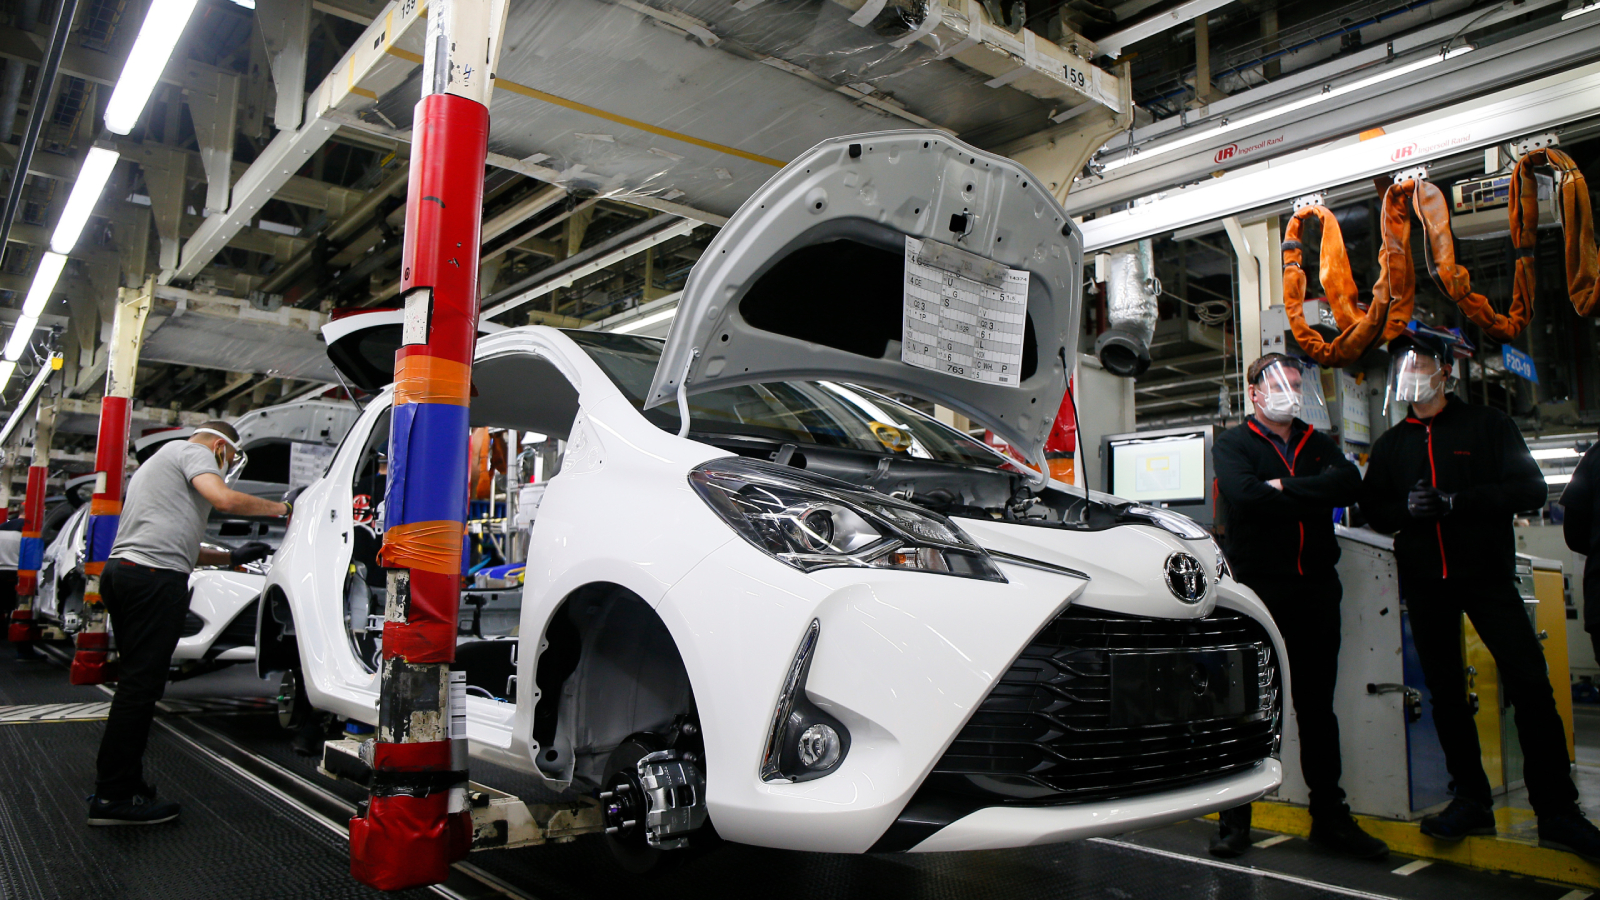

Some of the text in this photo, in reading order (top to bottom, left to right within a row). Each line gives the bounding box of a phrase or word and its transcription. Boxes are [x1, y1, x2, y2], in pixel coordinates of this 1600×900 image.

[402, 0, 416, 19] 159
[1062, 64, 1085, 87] 159
[1238, 141, 1266, 155] Ingersoll
[1267, 135, 1284, 146] Rand
[1418, 140, 1450, 154] Ingersoll
[1451, 134, 1471, 146] Rand
[948, 278, 954, 286] U
[1000, 294, 1005, 302] 5
[921, 302, 926, 310] 3
[944, 298, 950, 307] S
[980, 330, 986, 338] 6
[980, 340, 984, 348] L
[924, 346, 928, 354] P
[947, 364, 964, 374] 763
[1002, 365, 1008, 373] P
